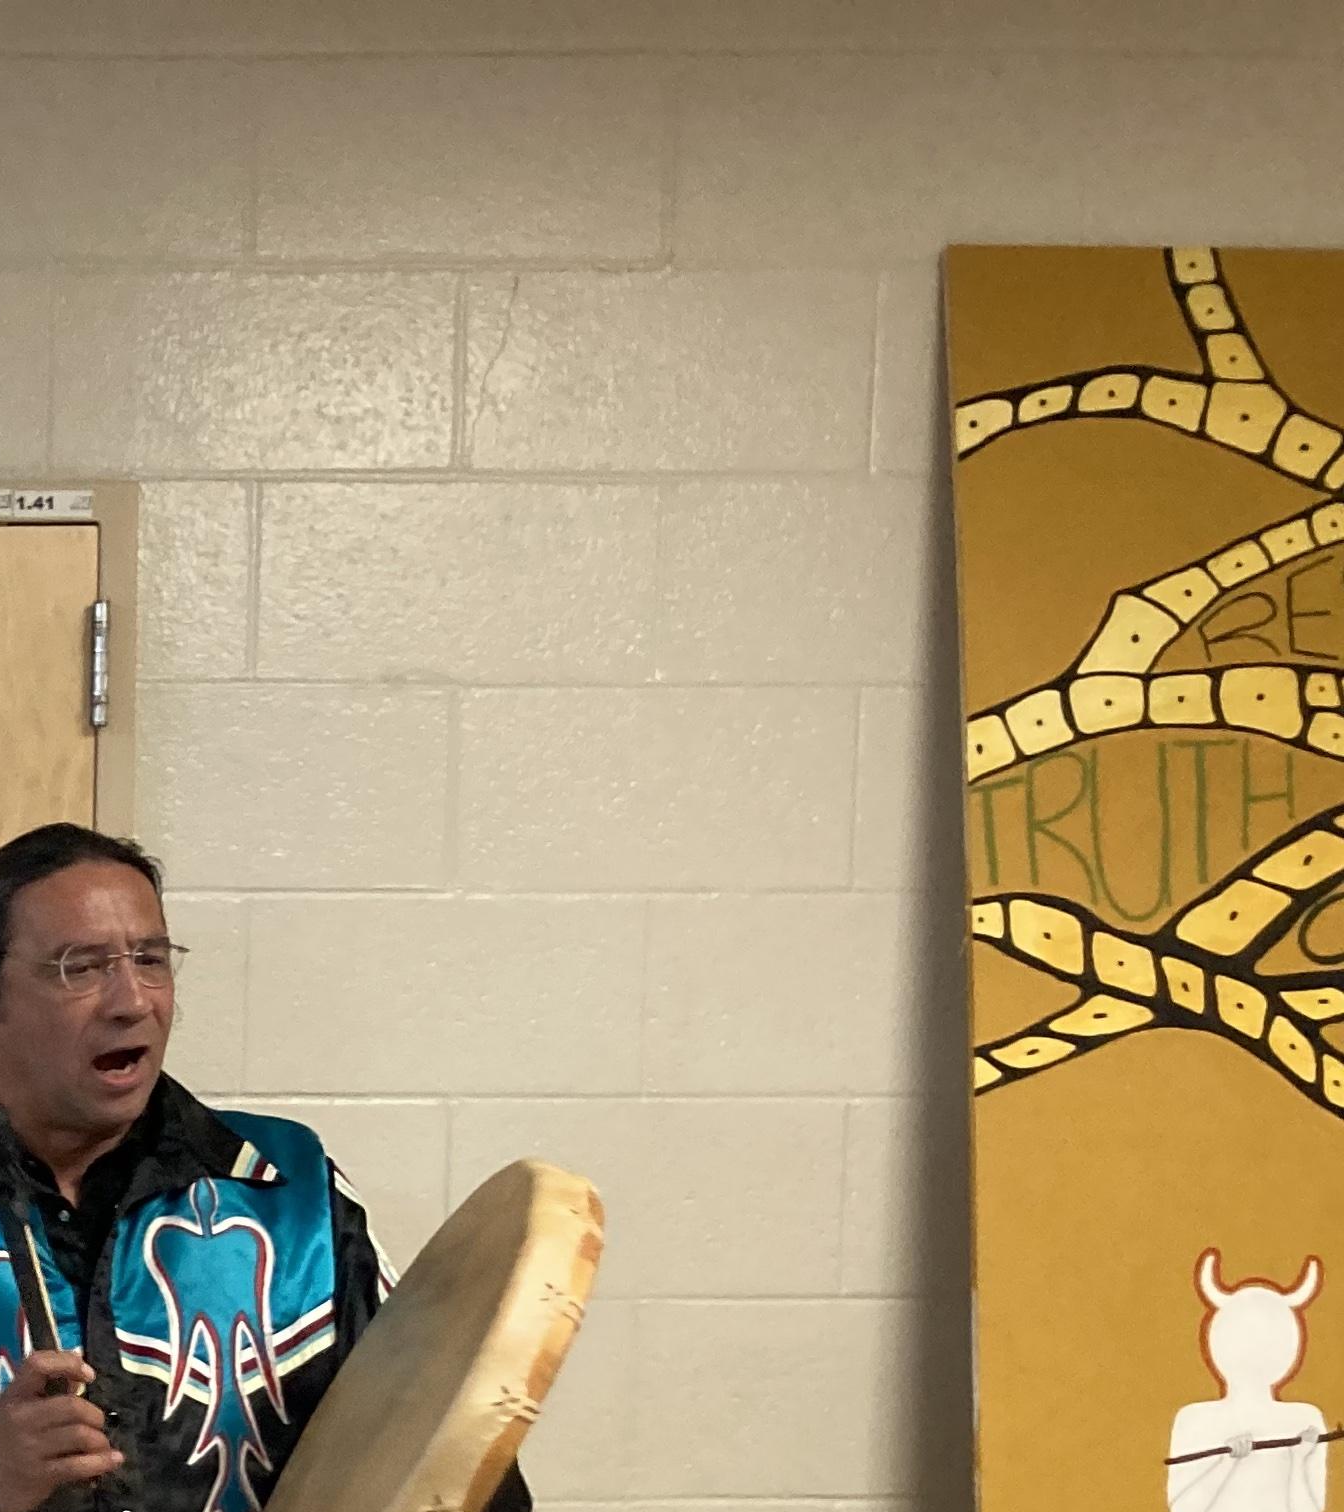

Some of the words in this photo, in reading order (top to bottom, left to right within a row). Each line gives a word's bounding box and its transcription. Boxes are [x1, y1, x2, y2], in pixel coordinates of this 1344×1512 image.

[16, 496, 55, 510] 1.41
[1198, 555, 1344, 662] RE
[970, 738, 1296, 923] TRUTH
